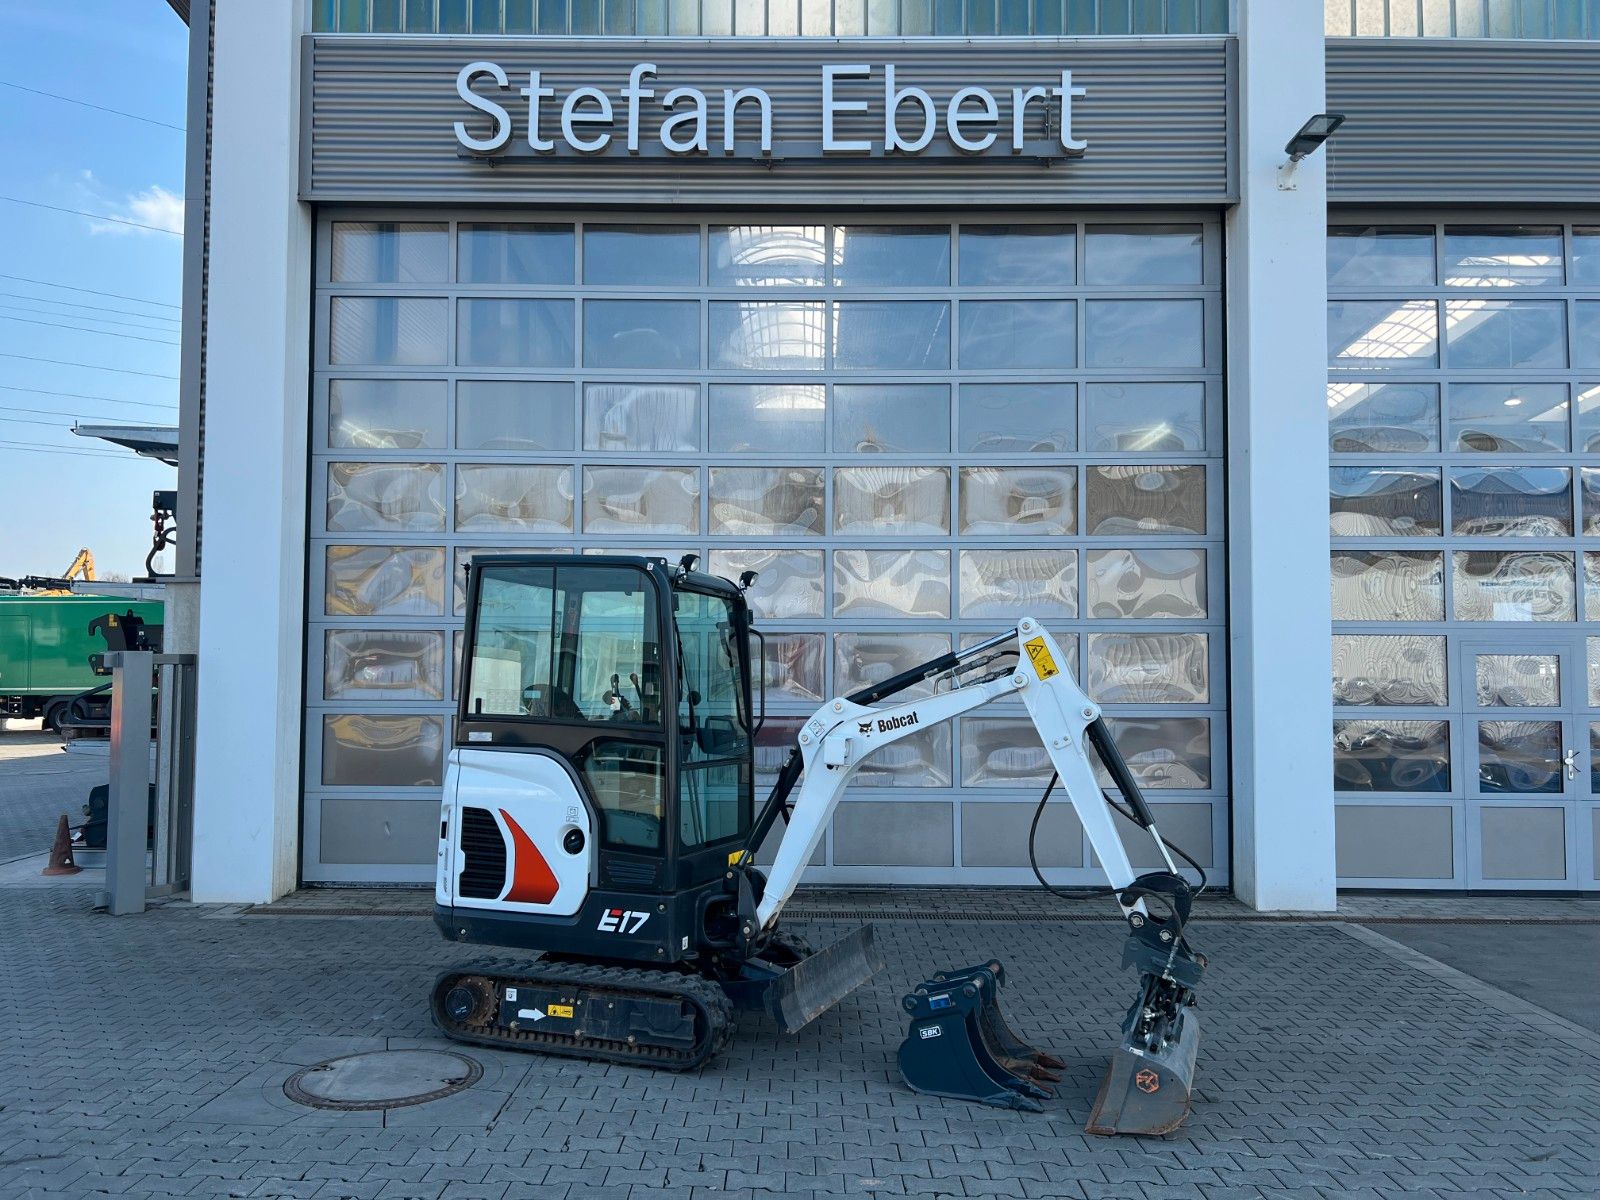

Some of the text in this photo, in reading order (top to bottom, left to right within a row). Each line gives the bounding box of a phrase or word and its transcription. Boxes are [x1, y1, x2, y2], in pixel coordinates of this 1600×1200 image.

[453, 61, 1087, 152] Stefan Ebert
[877, 711, 919, 733] Bobcat
[597, 908, 650, 934] E17
[921, 1028, 939, 1038] SBK
